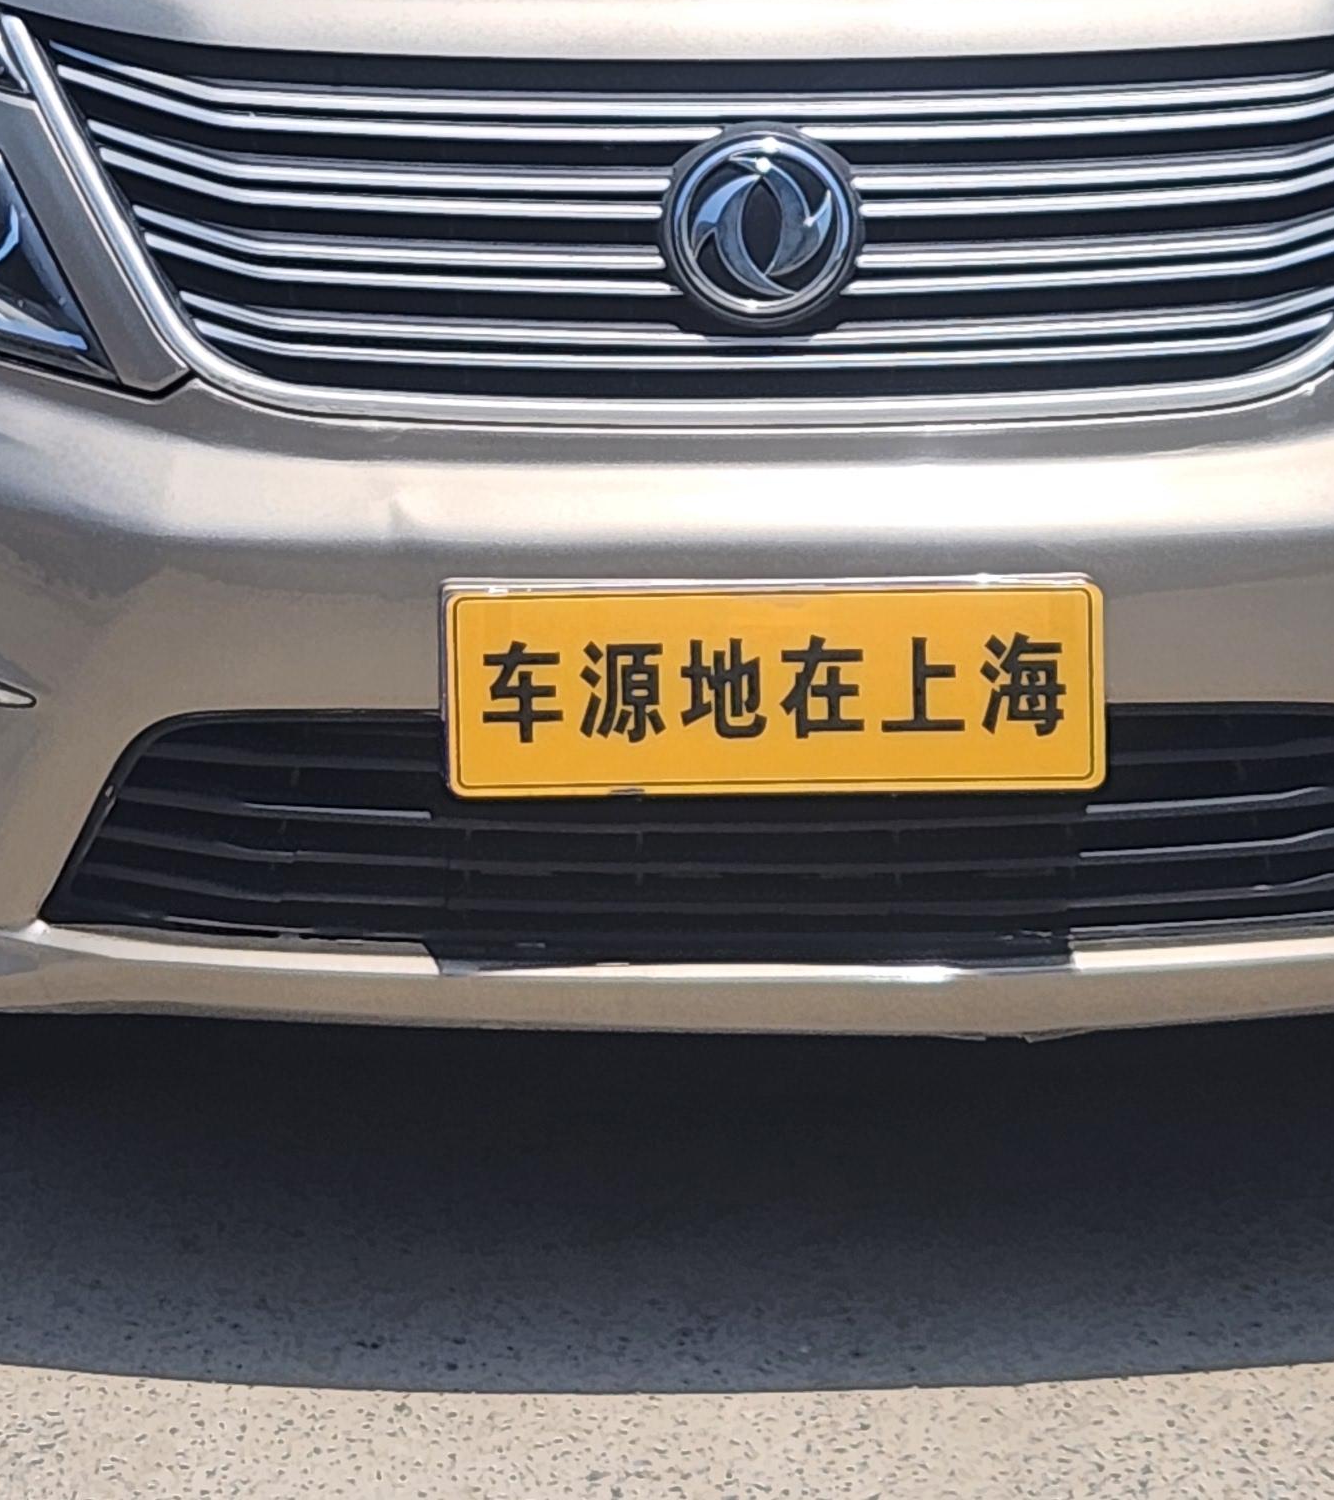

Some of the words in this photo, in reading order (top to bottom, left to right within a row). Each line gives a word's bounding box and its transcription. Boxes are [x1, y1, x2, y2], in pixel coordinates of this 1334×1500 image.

[482, 633, 1066, 743] 车源地在上海
